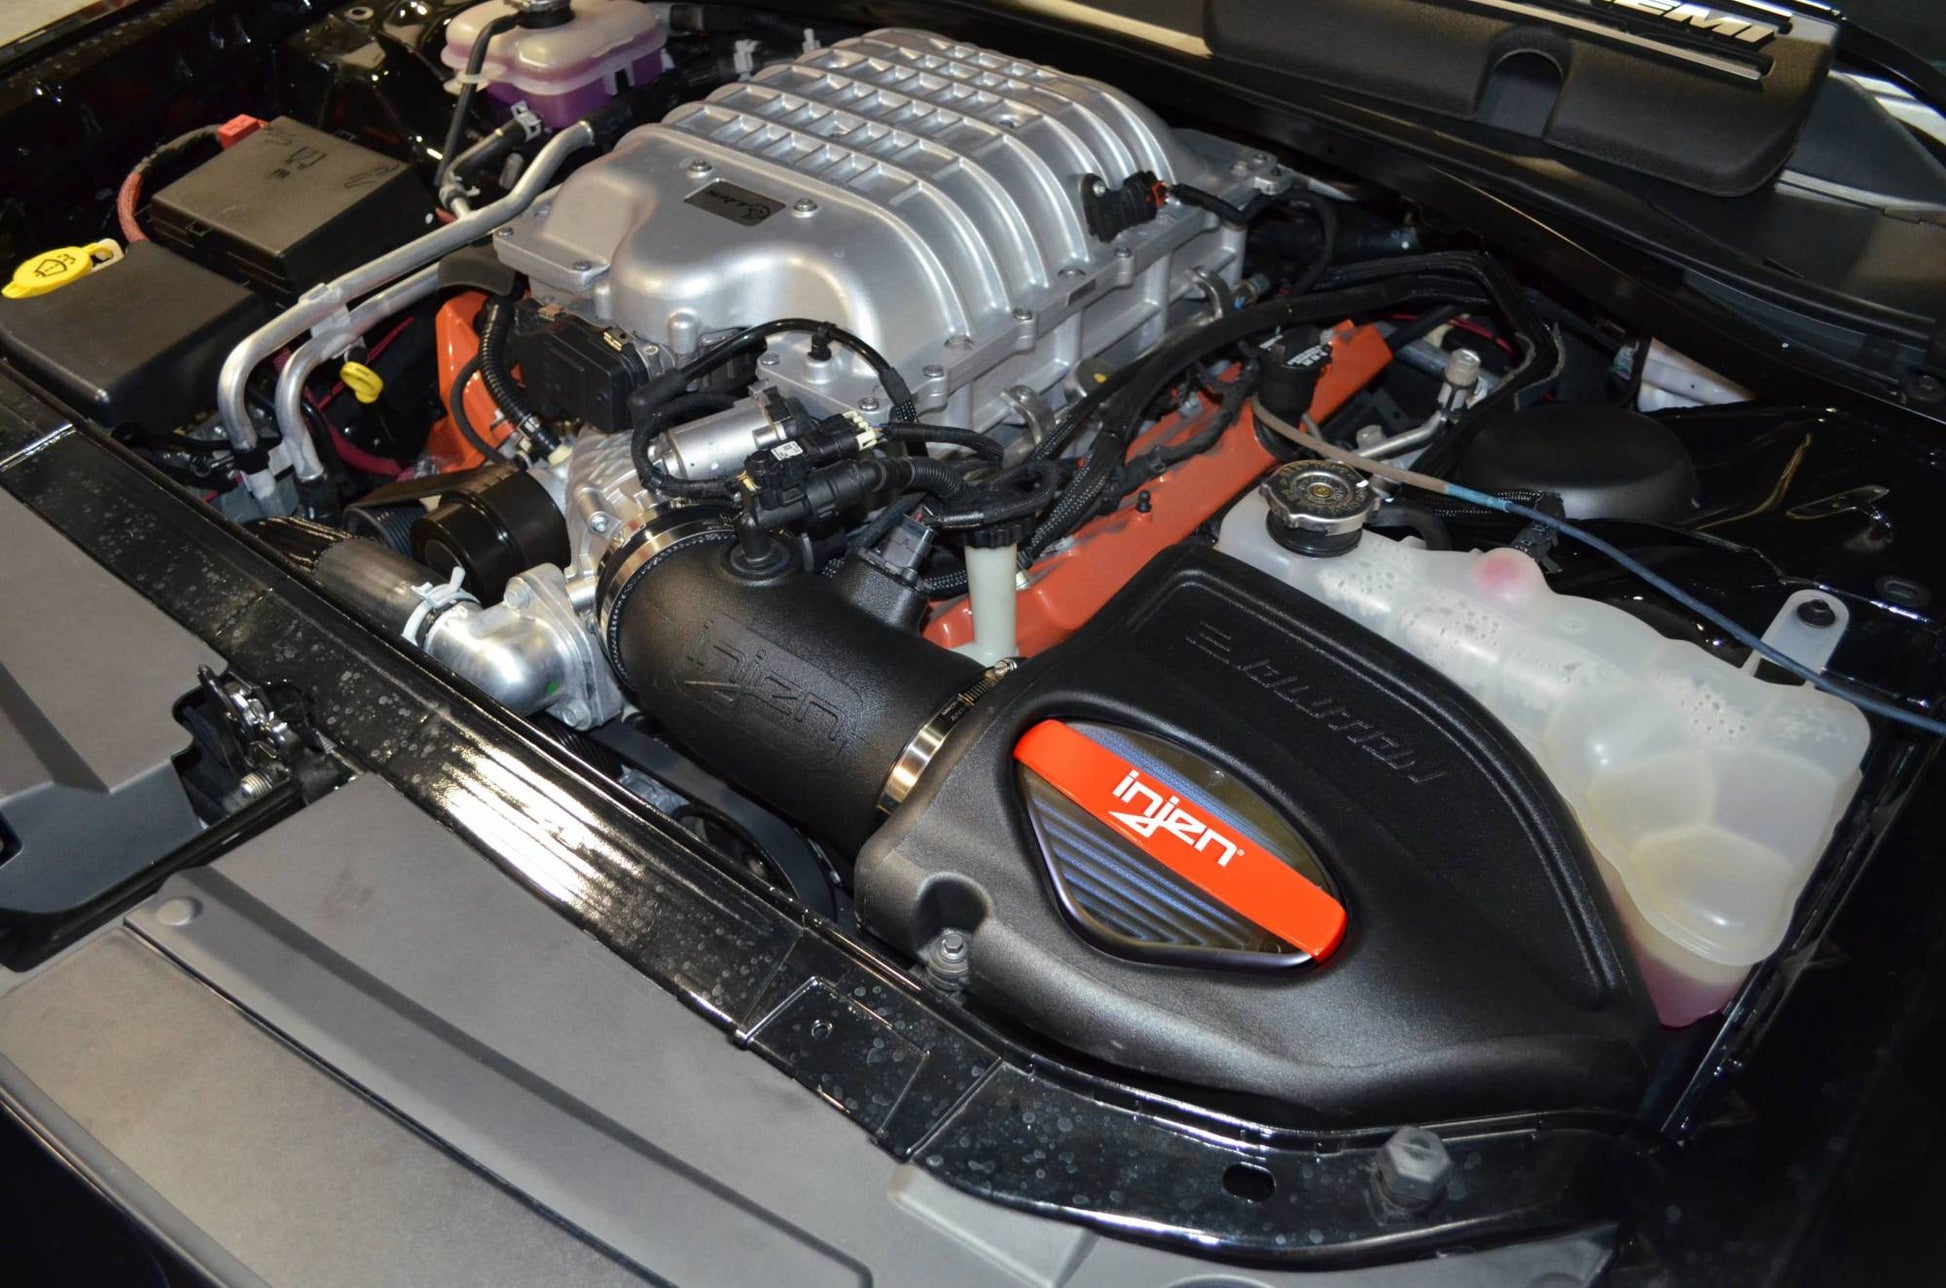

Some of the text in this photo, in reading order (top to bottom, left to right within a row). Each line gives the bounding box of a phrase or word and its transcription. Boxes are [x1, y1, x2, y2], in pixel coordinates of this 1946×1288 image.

[1601, 0, 1776, 43] EMI
[1186, 621, 1449, 785] EVOLUTION
[1108, 769, 1239, 868] injen
